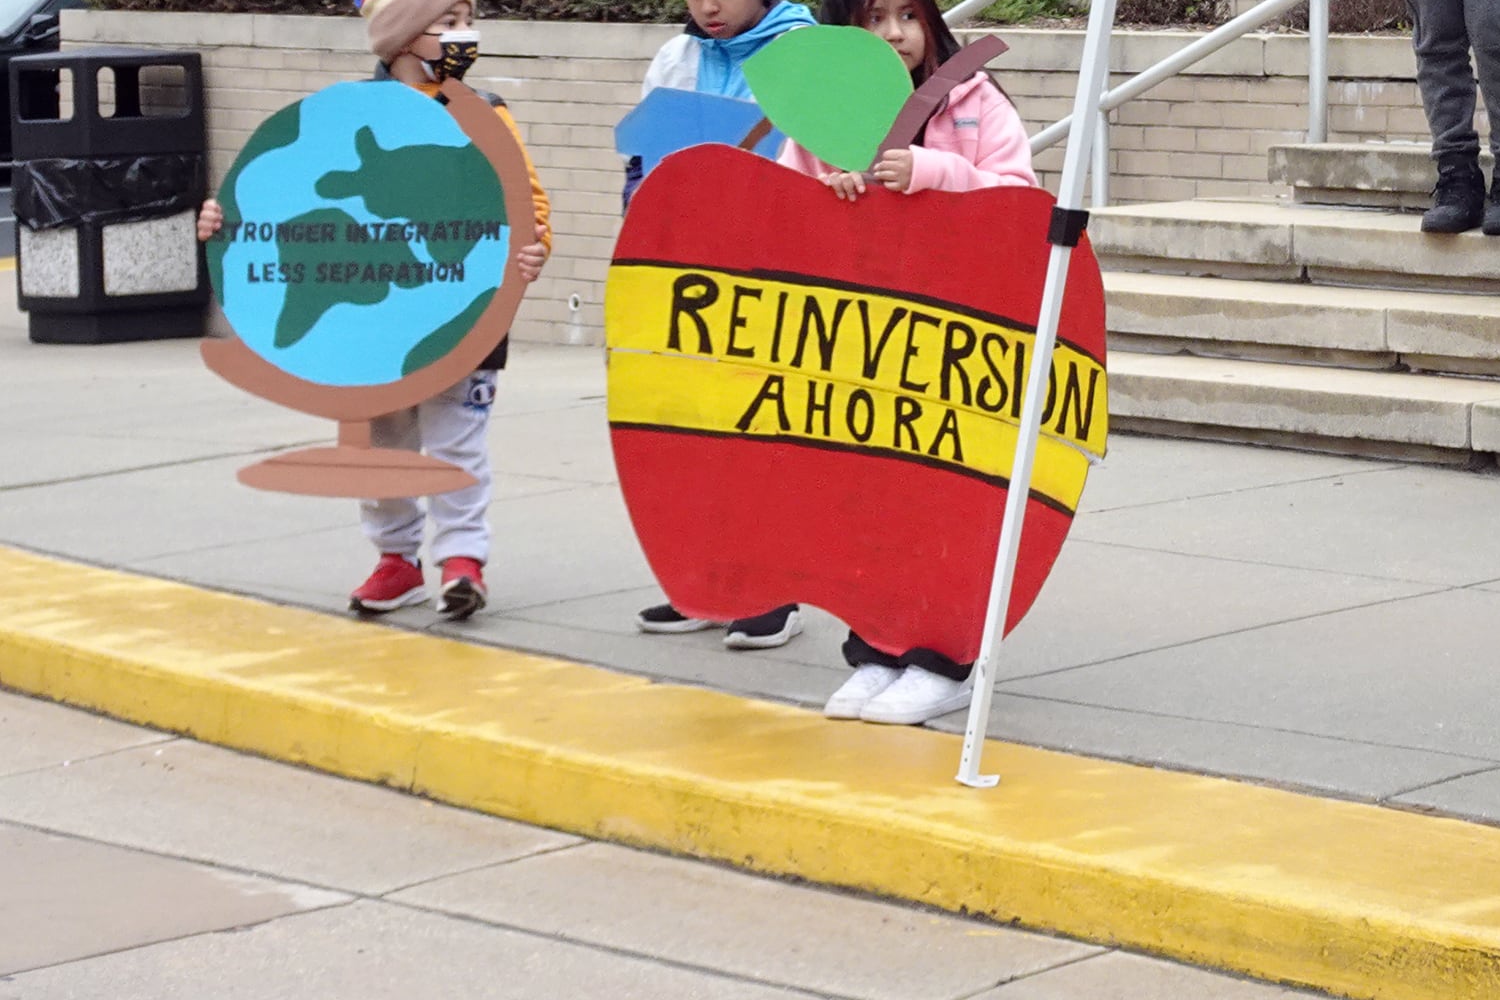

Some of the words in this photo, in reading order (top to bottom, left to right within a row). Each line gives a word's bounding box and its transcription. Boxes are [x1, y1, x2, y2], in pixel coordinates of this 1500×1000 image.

[212, 221, 335, 243] STRONGER
[346, 220, 501, 243] INTEGRATION
[248, 262, 305, 283] LESS
[314, 262, 465, 283] SEPARATION
[735, 375, 964, 462] AHORA
